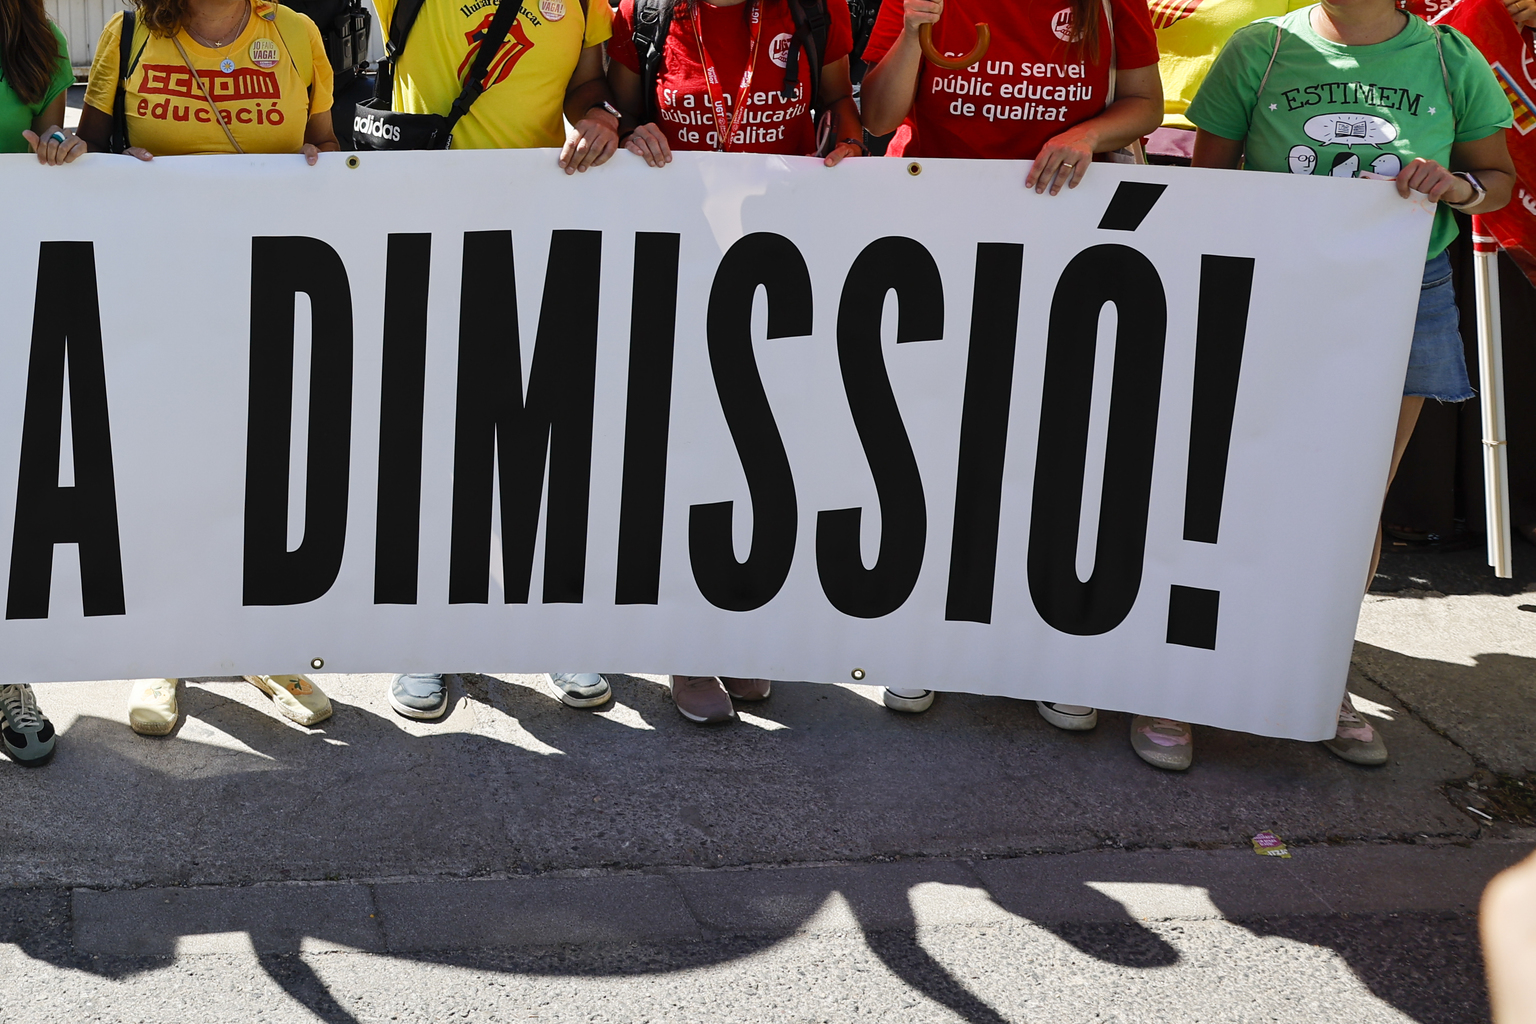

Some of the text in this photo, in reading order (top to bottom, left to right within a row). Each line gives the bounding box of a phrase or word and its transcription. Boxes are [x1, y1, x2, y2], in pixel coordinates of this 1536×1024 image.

[541, 1, 564, 13] VAGA!
[751, 7, 759, 24] UGT
[253, 41, 274, 51] JO FAIG
[253, 49, 276, 60] VAGA!
[986, 61, 1014, 76] un
[1021, 60, 1085, 79] servei
[932, 74, 1092, 101] públic educatiu
[683, 93, 695, 107] a
[1281, 81, 1424, 116] ESTIMEM
[137, 97, 284, 125] educació
[714, 100, 724, 117] UGT
[949, 98, 1068, 123] de qualitat
[353, 114, 401, 142] adidas
[678, 127, 700, 143] de
[242, 180, 1255, 650] DIMISSIÓ!
